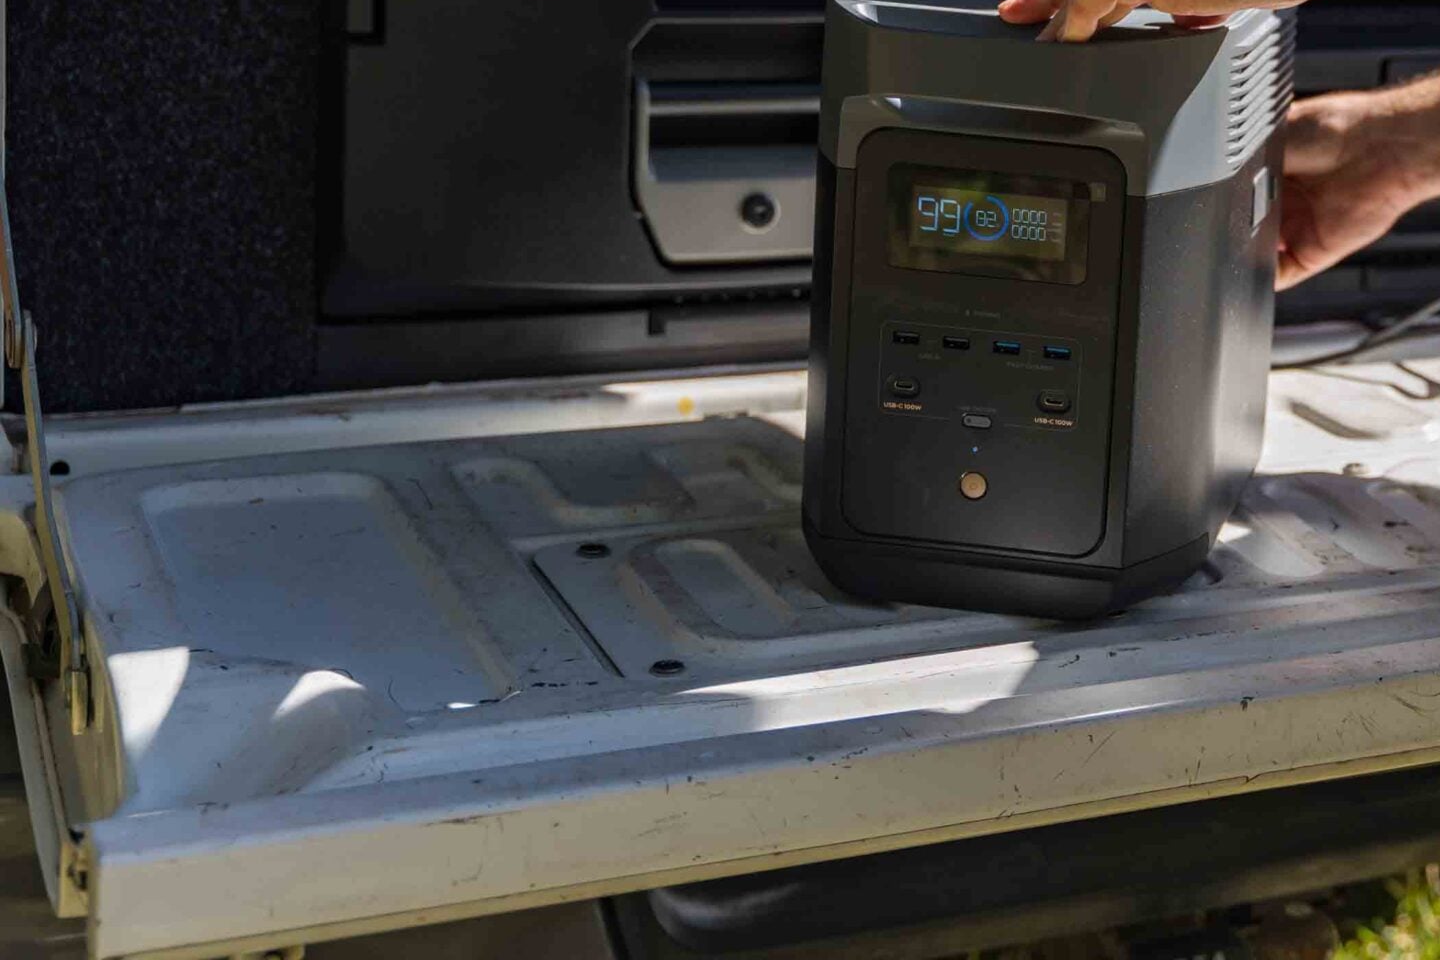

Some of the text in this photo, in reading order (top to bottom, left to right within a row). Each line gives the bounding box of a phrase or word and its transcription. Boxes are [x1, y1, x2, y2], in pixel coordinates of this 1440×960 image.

[917, 196, 961, 235] 99
[1012, 208, 1047, 225] 0000
[1011, 224, 1046, 241] 0000
[883, 401, 922, 412] USB-C 100W
[1034, 417, 1073, 427] USB-C 100W
